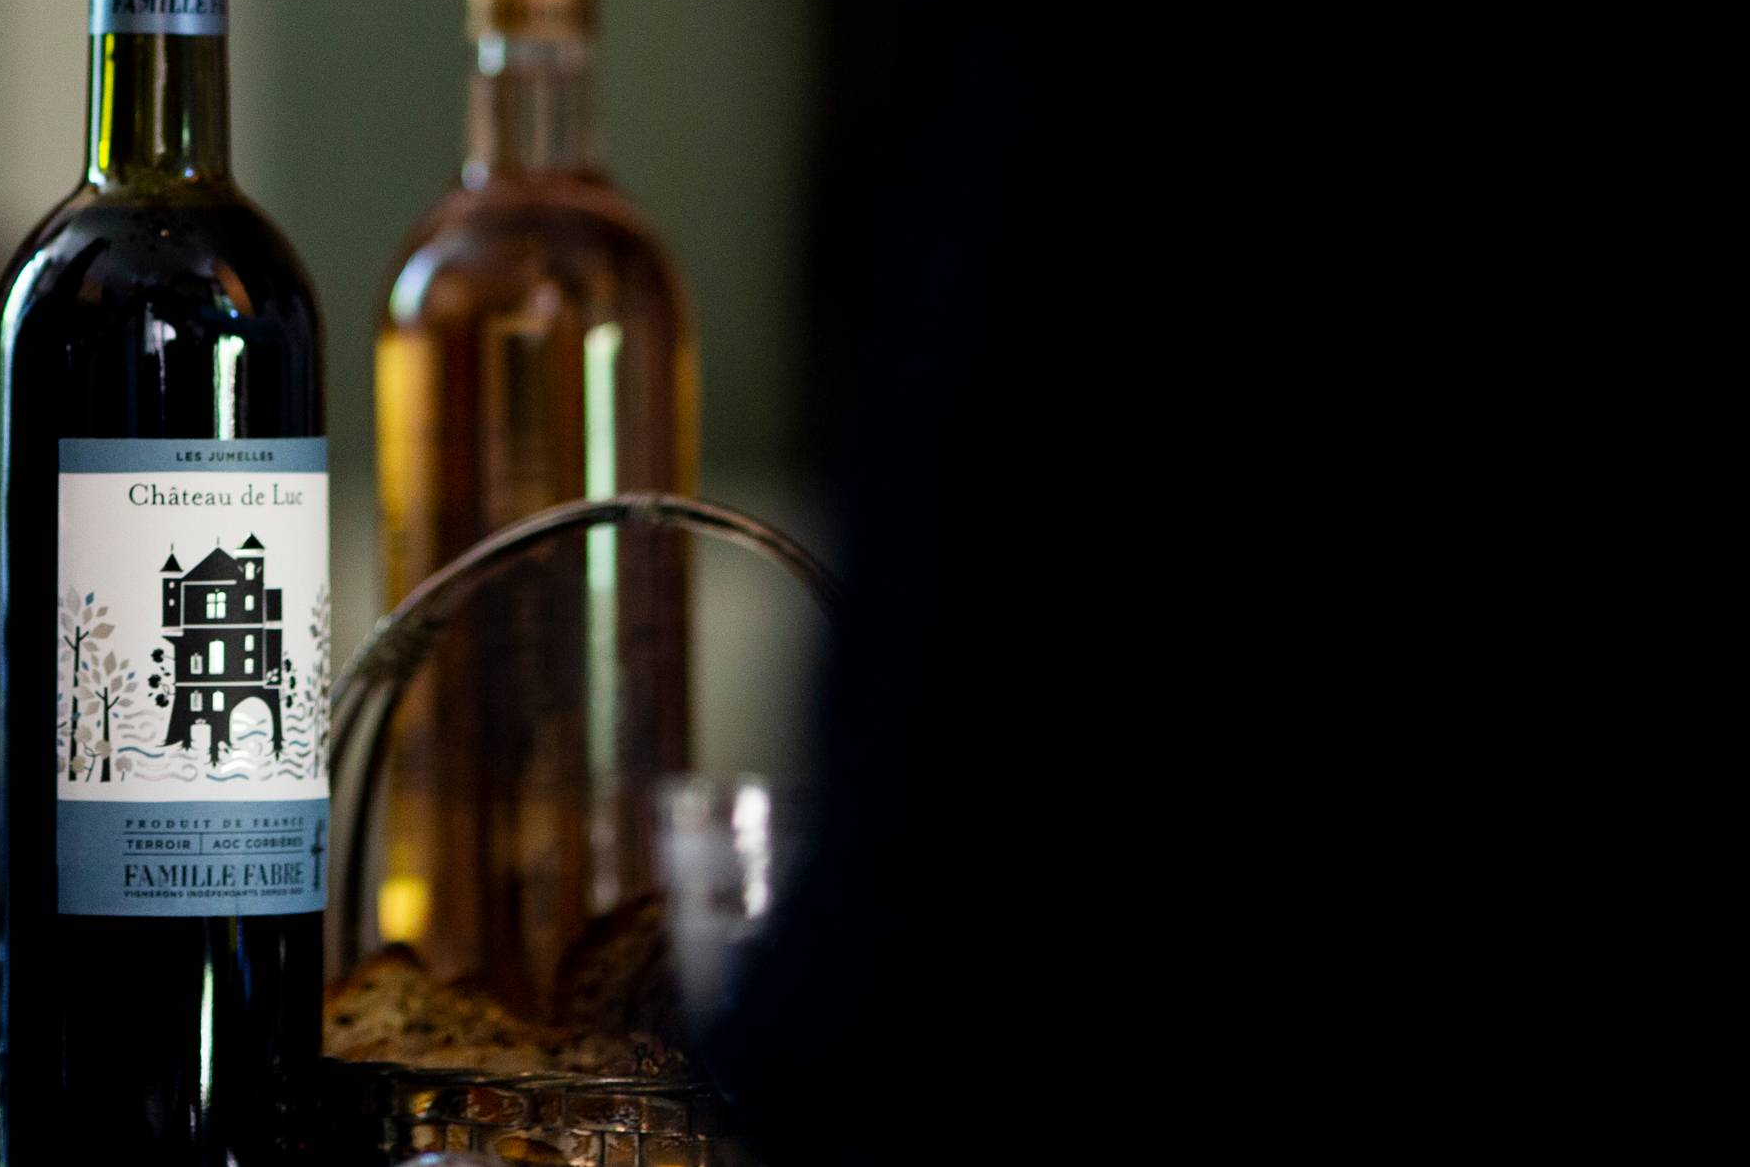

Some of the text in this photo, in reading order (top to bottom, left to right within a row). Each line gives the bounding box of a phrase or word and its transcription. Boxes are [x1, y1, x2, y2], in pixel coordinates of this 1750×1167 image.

[175, 451, 274, 462] LES JUMELLES
[128, 483, 303, 506] Château de Luc
[125, 818, 211, 829] PRODUIT
[222, 818, 242, 828] DE
[126, 839, 191, 850] TERROIR
[212, 838, 241, 850] AOC
[124, 862, 305, 887] FAMILLE FABRE
